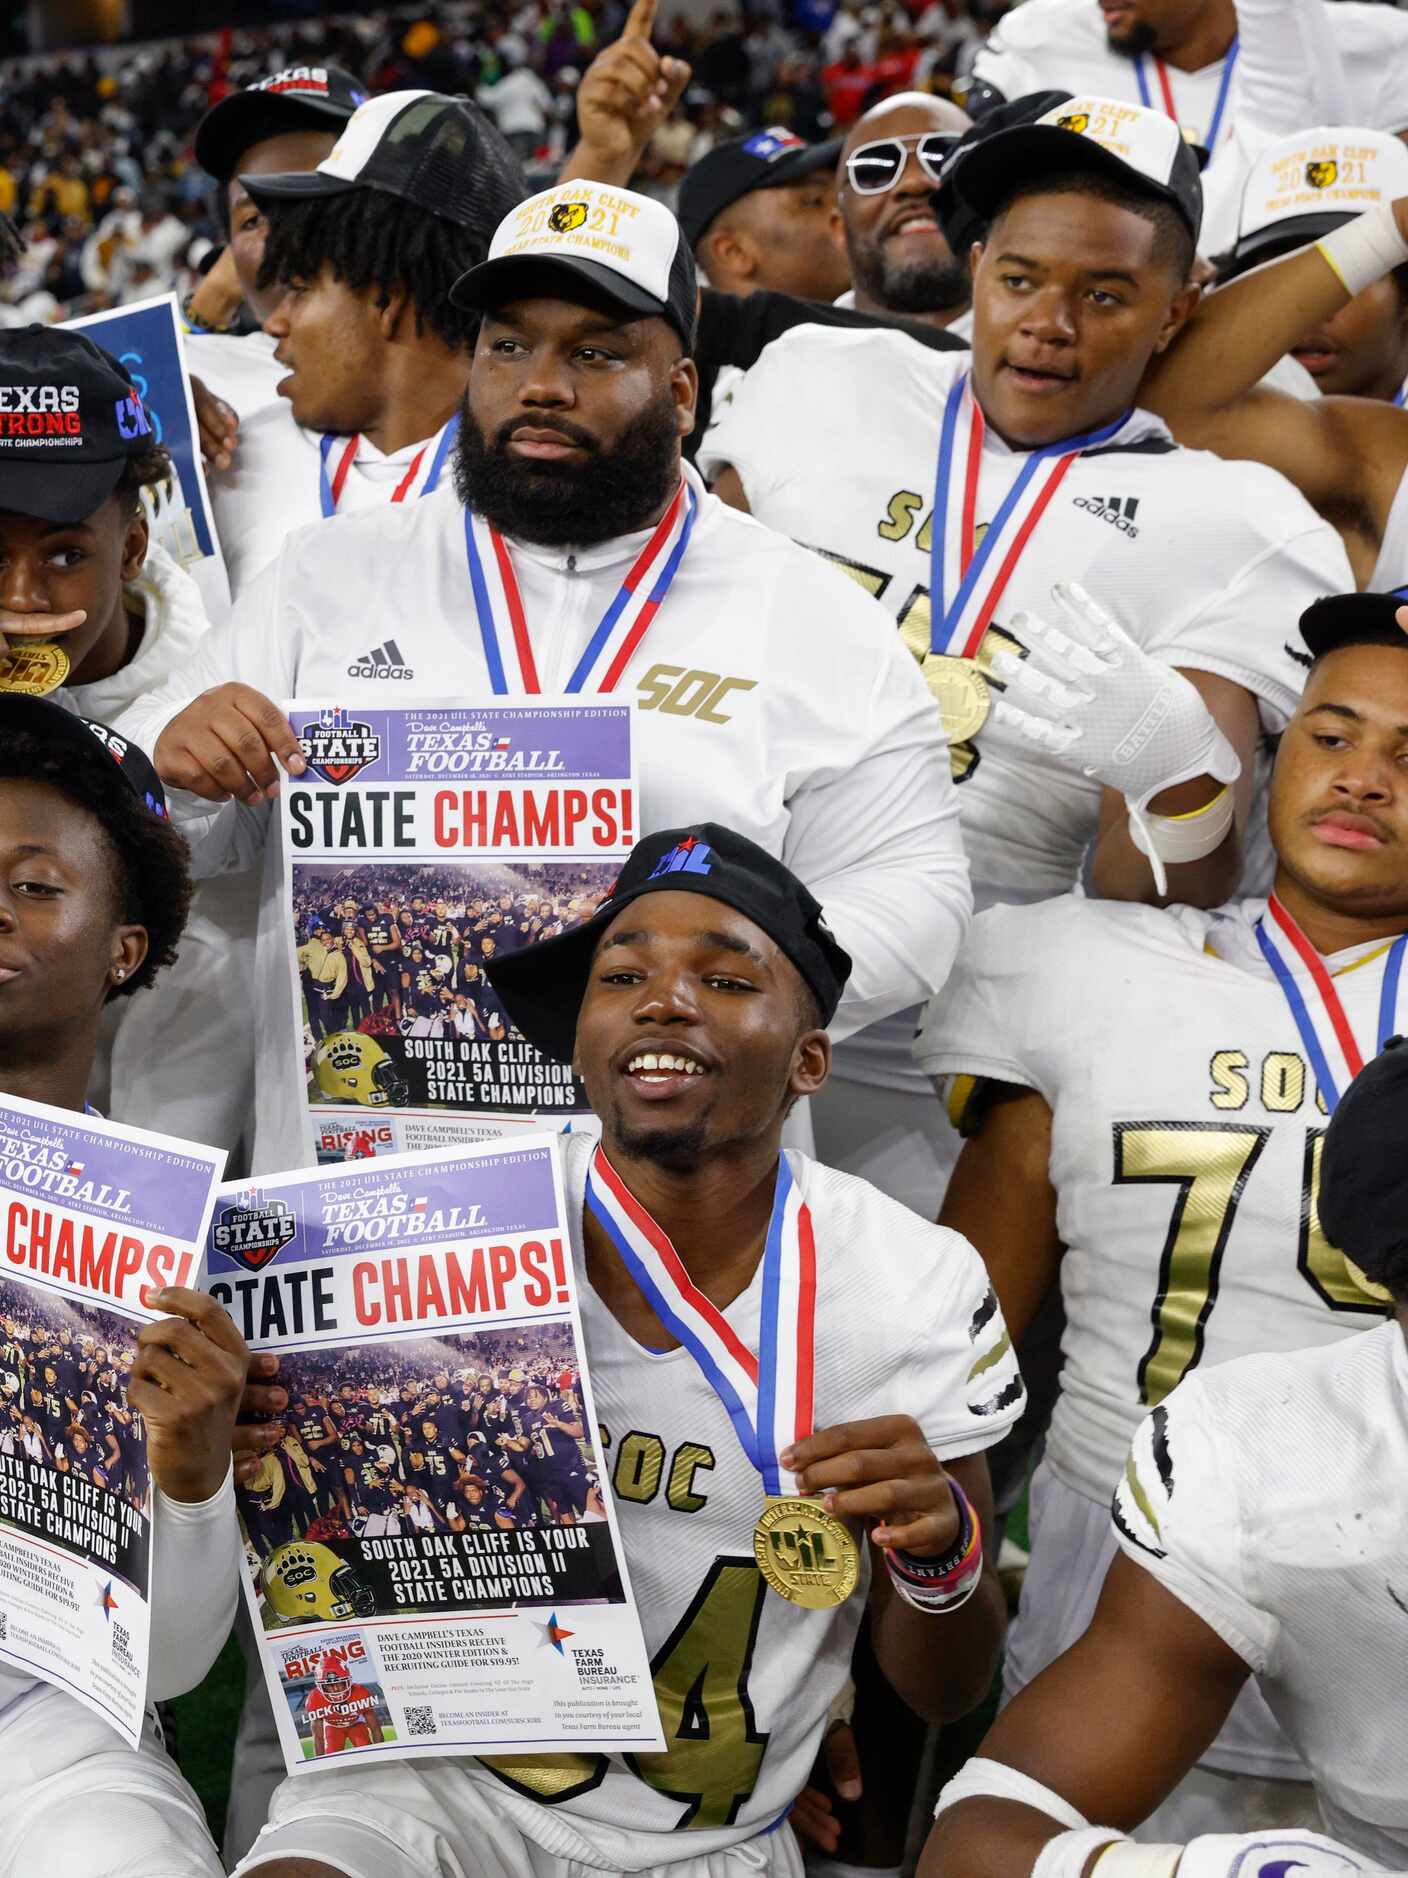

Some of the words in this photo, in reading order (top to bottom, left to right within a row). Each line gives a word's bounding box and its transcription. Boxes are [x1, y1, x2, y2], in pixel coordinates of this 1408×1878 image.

[1342, 163, 1367, 184] 21
[598, 193, 640, 218] CLIFF
[588, 208, 619, 237] 21
[14, 437, 83, 448] CHAMPIONSHIPS
[1072, 497, 1140, 539] adidas
[347, 663, 414, 681] adidas
[636, 663, 759, 725] SOC
[318, 708, 353, 728] UIL
[502, 710, 581, 720] CHAMPIONSHIP
[584, 709, 628, 719] EDITION
[297, 737, 379, 758] STATE
[405, 733, 493, 751] TEXAS
[404, 750, 564, 772] FOOTBALL
[289, 791, 417, 848] STATE
[434, 789, 633, 847] CHAMPS!
[647, 838, 712, 880] UIL
[404, 1039, 454, 1060] SOUTH
[460, 1043, 491, 1061] OAK
[426, 1061, 466, 1081] 2021
[473, 1063, 493, 1083] 5A
[499, 1064, 572, 1084] DIVISION
[1209, 1050, 1329, 1113] SO
[427, 1081, 474, 1101] STATE
[480, 1084, 575, 1105] CHAMPIONS
[232, 1209, 275, 1222] FOOTBALL
[320, 1193, 410, 1224] TEXAS
[213, 1216, 294, 1246] STATE
[319, 1203, 488, 1247] FOOTBALL
[7, 1202, 194, 1310] CHAMPS!
[230, 1238, 279, 1252] CHAMPIONSHIPS
[353, 1239, 570, 1327] CHAMPS!
[0, 1474, 35, 1504] 2021
[40, 1488, 59, 1514] 5A
[63, 1497, 117, 1542] DIVISION
[120, 1526, 129, 1550] II
[30, 1464, 57, 1491] OAK
[62, 1475, 99, 1508] CLIFF
[103, 1492, 116, 1517] IS
[119, 1501, 144, 1538] YOUR
[0, 1494, 41, 1527] STATE
[46, 1511, 118, 1565] CHAMPIONS
[360, 1537, 417, 1561] SOUTH
[421, 1535, 457, 1557] OAK
[462, 1531, 511, 1554] CLIFF
[516, 1530, 536, 1552] IS
[540, 1526, 590, 1550] YOUR
[285, 1567, 312, 1581] SOC
[387, 1558, 434, 1582] 2021
[439, 1557, 464, 1579] 5A
[468, 1552, 546, 1578] DIVISION
[551, 1551, 566, 1573] II
[393, 1580, 447, 1604] STATE
[451, 1573, 554, 1601] CHAMPIONS
[377, 1633, 399, 1643] DAVE
[401, 1629, 454, 1641] CAMPBELL'S
[456, 1627, 484, 1637] TEXAS
[379, 1641, 424, 1652] FOOTBALL
[426, 1638, 467, 1649] INSIDERS
[468, 1636, 506, 1647] RECEIVE
[381, 1653, 399, 1662] THE
[401, 1652, 422, 1661] 2020
[423, 1649, 460, 1660] WINTER
[462, 1647, 499, 1658] EDITION
[500, 1647, 509, 1655] &
[571, 1647, 604, 1659] TEXAS
[575, 1656, 603, 1667] FARM
[384, 1661, 437, 1673] RECRUITING
[440, 1659, 469, 1669] GUIDE
[470, 1658, 488, 1667] FOR
[577, 1664, 617, 1677] BUREAU
[578, 1673, 638, 1686] INSURANCE
